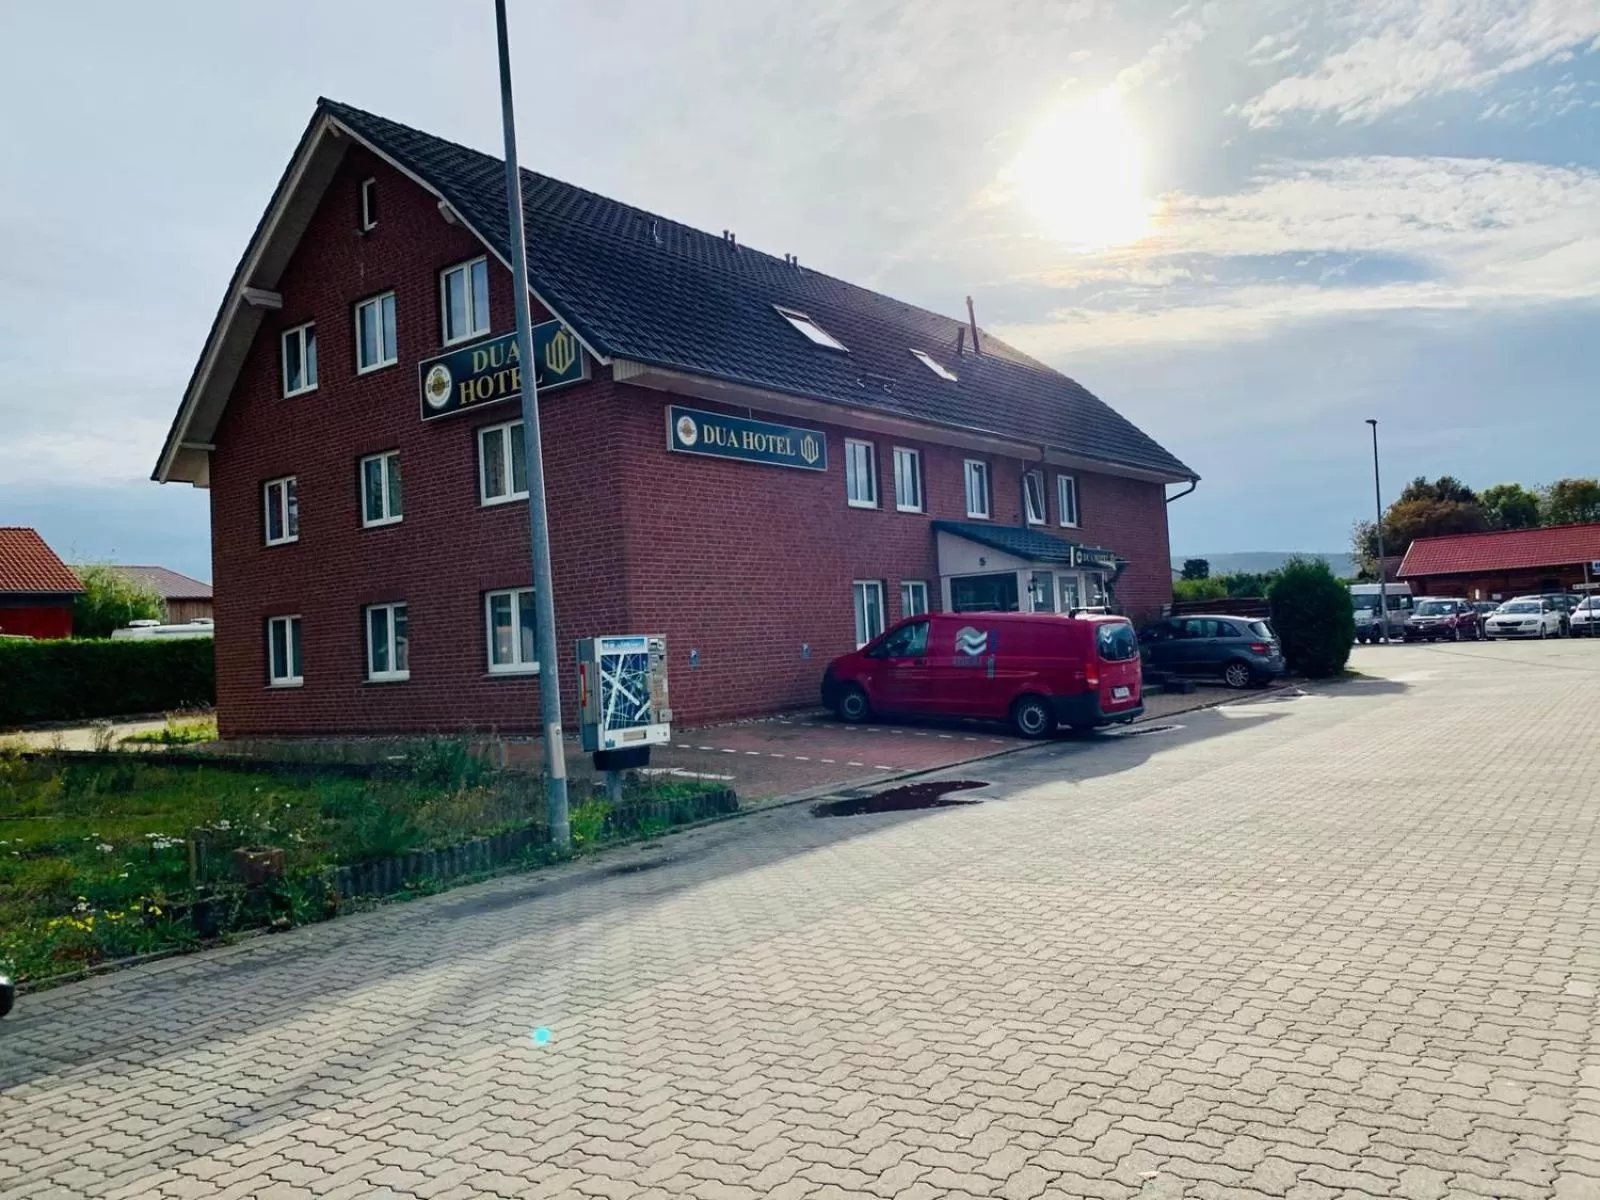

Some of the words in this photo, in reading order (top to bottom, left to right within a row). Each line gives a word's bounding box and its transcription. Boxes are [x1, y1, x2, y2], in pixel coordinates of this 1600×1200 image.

[473, 340, 521, 373] DUA
[458, 366, 543, 405] HOTE
[702, 423, 739, 448] DUA
[742, 430, 796, 456] HOTEL
